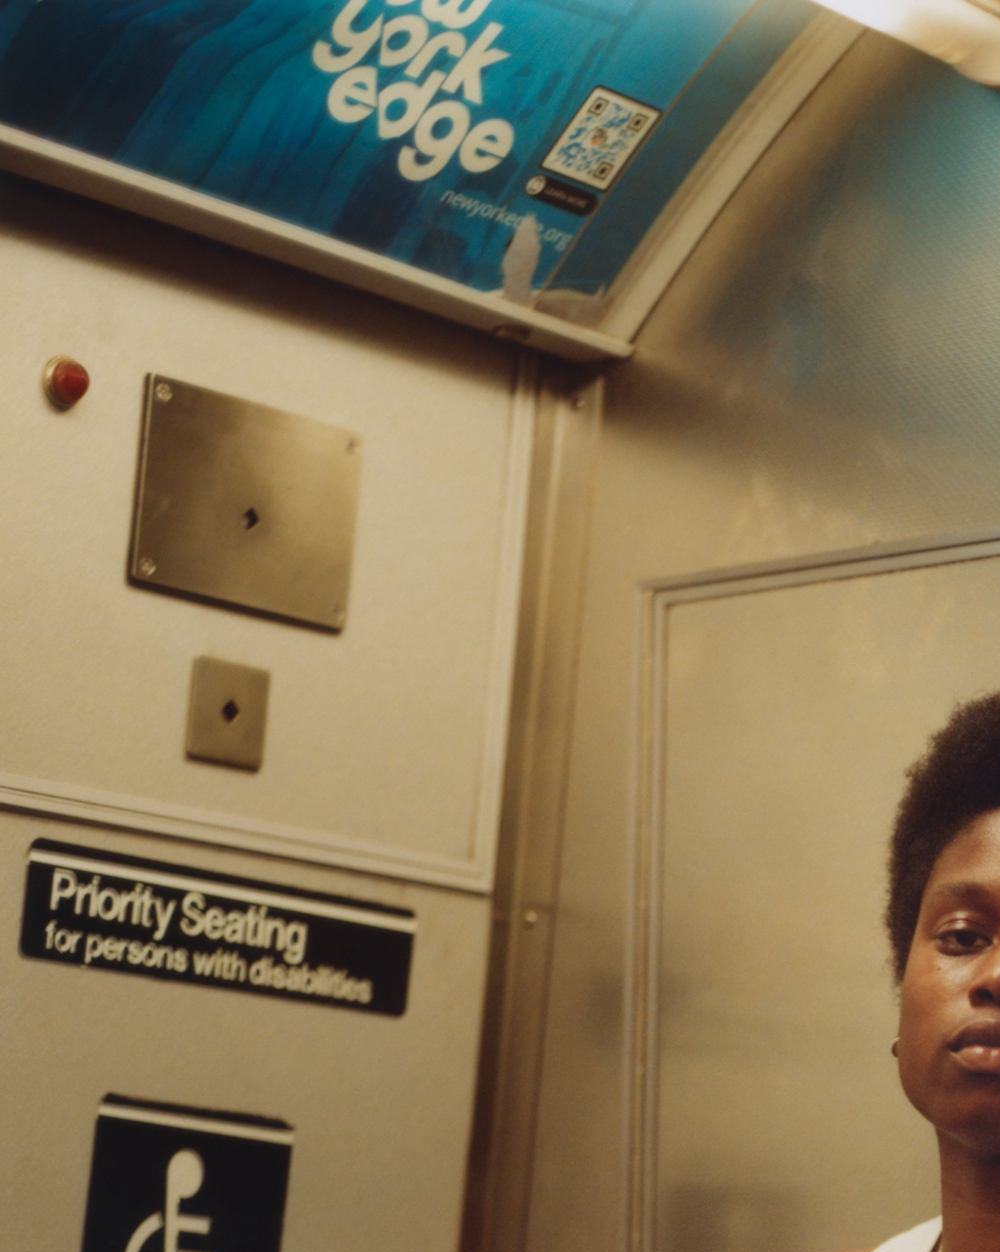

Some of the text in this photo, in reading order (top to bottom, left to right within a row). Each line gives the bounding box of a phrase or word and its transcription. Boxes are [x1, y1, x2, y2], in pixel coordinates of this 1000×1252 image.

[312, 0, 511, 105] york
[327, 65, 515, 182] edge
[440, 190, 573, 251] newyorkee.org
[45, 919, 373, 1005] for persons with disabilities
[50, 867, 308, 966] Priority Seating
